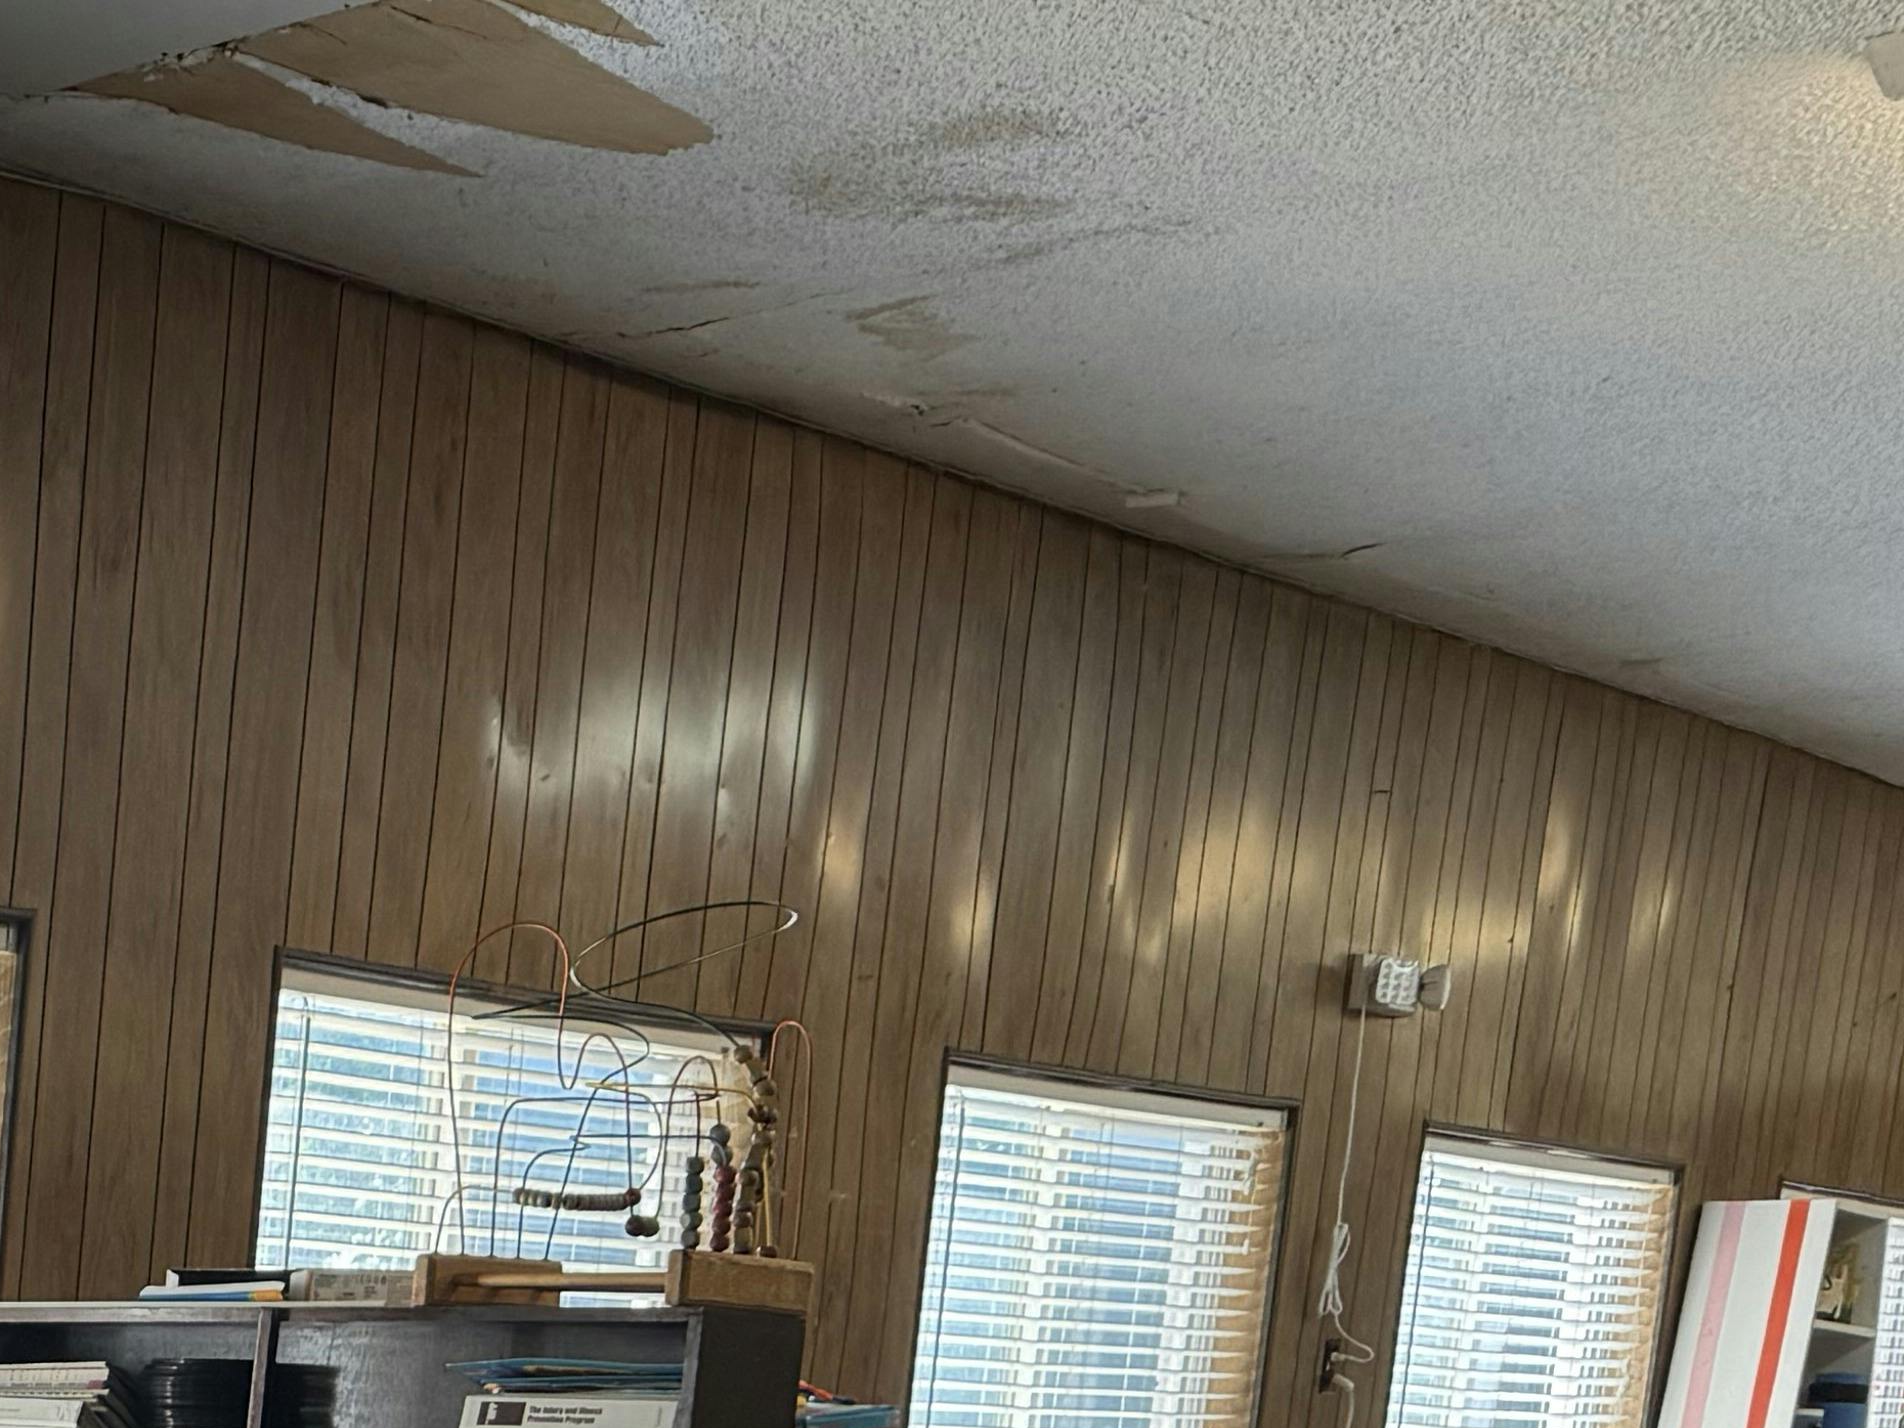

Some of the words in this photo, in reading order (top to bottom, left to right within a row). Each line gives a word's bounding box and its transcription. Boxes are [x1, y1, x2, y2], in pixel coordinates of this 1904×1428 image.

[530, 1406, 541, 1414] The
[527, 1415, 563, 1423] Prevention
[565, 1416, 595, 1425] Program
